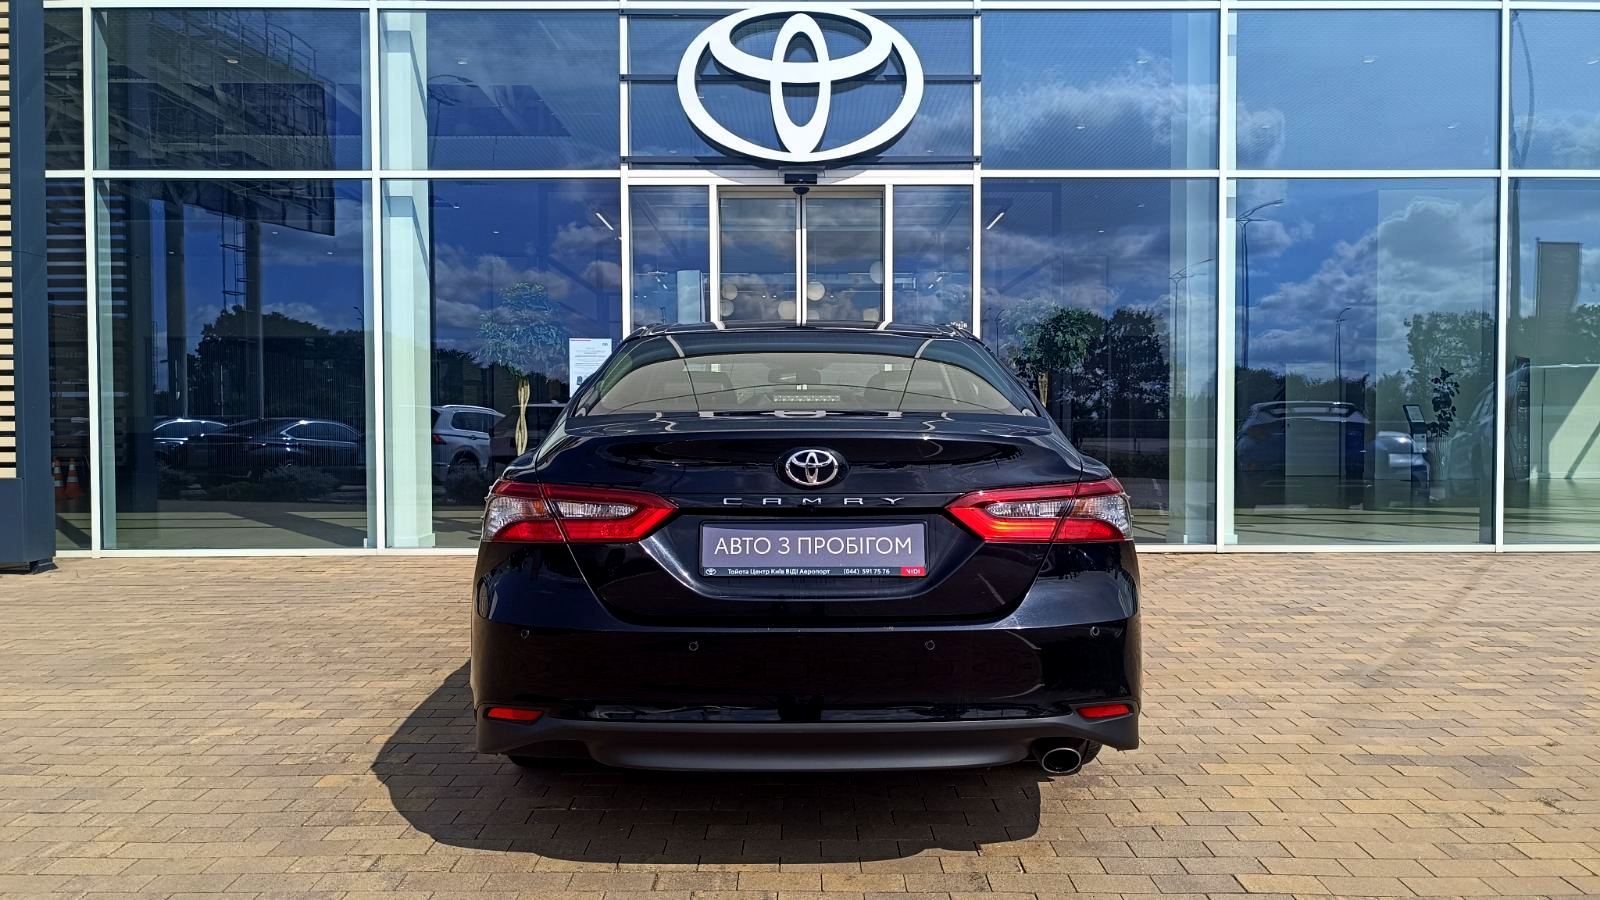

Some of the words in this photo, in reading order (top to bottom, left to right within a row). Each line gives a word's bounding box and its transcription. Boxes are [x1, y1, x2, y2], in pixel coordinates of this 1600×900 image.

[723, 497, 905, 506] CAMRY
[713, 537, 772, 555] АВТО
[777, 536, 791, 555] З
[797, 536, 912, 555] ПРОБІГОМ
[750, 568, 770, 576] Центр
[785, 568, 799, 576] ВІДІ
[799, 568, 831, 576] Аеропорт
[843, 568, 860, 576] (044)
